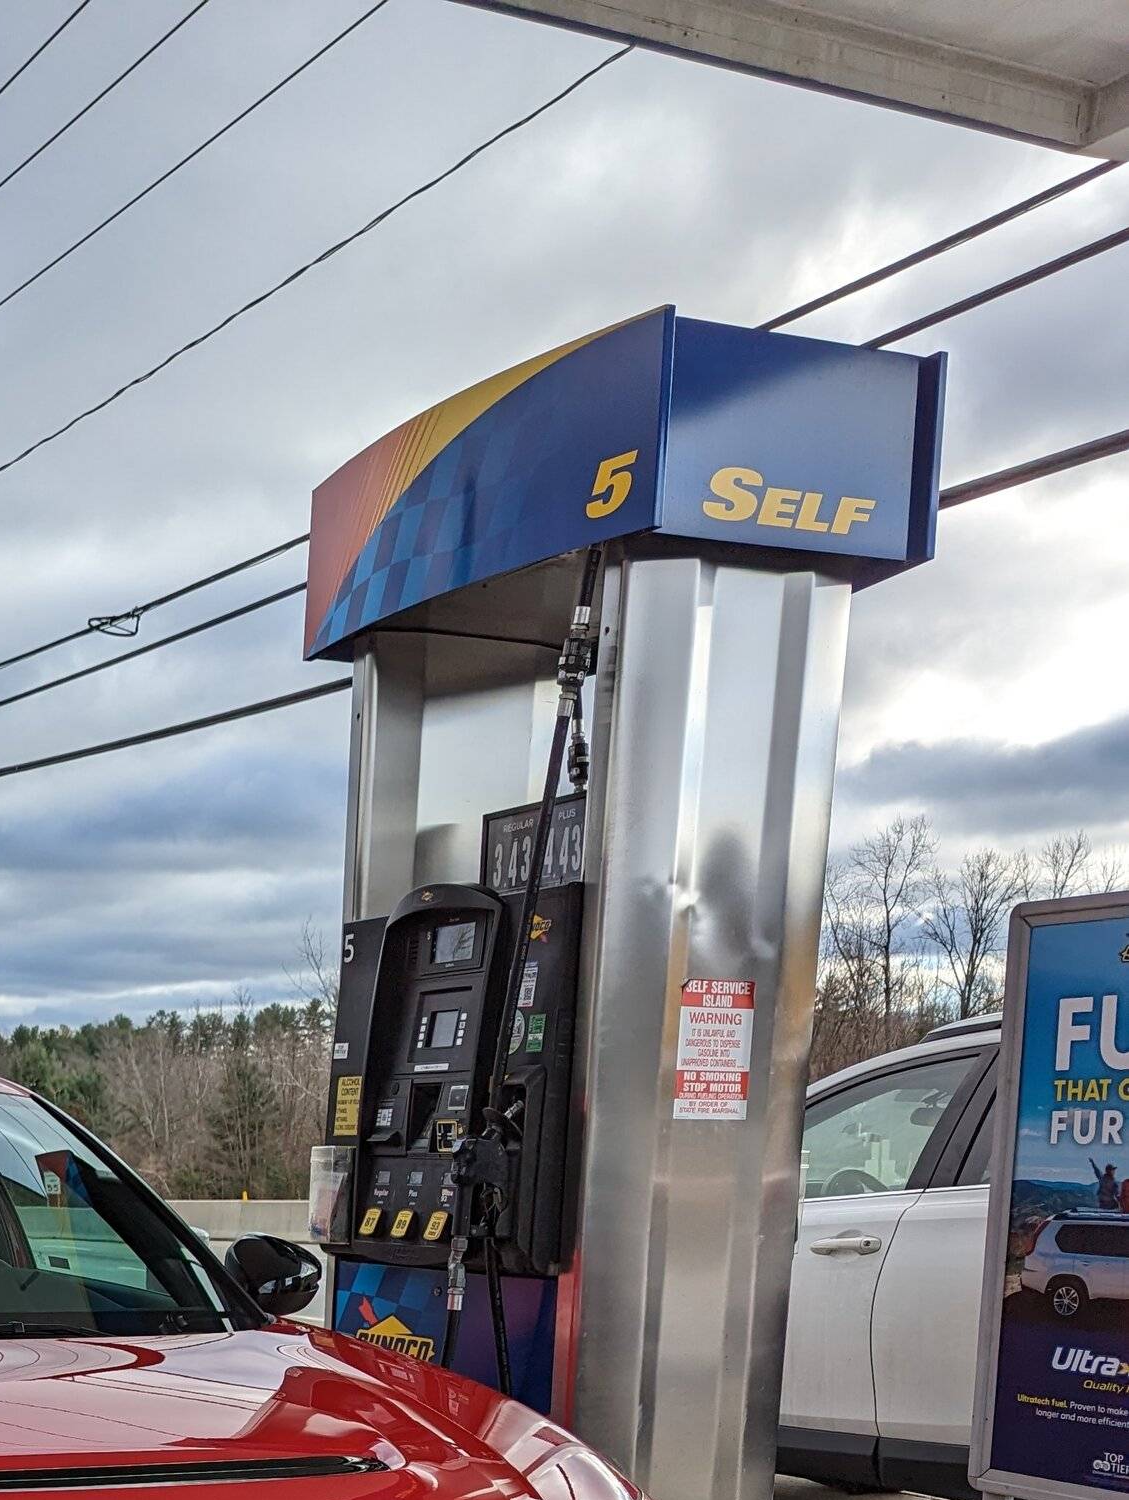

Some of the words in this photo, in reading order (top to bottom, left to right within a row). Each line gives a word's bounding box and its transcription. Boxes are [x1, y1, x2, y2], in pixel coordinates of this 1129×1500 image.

[585, 449, 638, 519] 5
[703, 467, 875, 535] SELF
[559, 808, 576, 820] PLUS
[503, 818, 534, 833] REGULAR
[344, 934, 354, 963] 5
[686, 980, 708, 993] SELF
[711, 981, 750, 995] SERVICE
[702, 994, 733, 1007] ISLAND
[689, 1012, 742, 1025] WARNING
[720, 1040, 741, 1048] DISPENSE
[698, 1048, 719, 1057] GASOLINE
[342, 1078, 360, 1086] ALCOHOL
[683, 1071, 696, 1081] NO
[699, 1072, 741, 1082] SMOKING
[341, 1088, 359, 1096] CONTENT
[683, 1082, 707, 1092] STOP
[710, 1083, 741, 1093] MOTOR
[1054, 1079, 1112, 1101] THAT
[364, 1217, 376, 1227] 87
[395, 1219, 407, 1229] 89
[430, 1220, 441, 1230] 93
[1052, 1347, 1120, 1376] Ultra
[1083, 1380, 1125, 1393] Quality
[1017, 1393, 1050, 1406] Ultratech
[1070, 1401, 1096, 1411] Proven
[1097, 1405, 1106, 1414] to
[1107, 1407, 1129, 1416] make
[1035, 1408, 1060, 1419] longer
[1060, 1413, 1076, 1421] and
[1077, 1416, 1096, 1425] more
[1104, 1452, 1124, 1463] TOP
